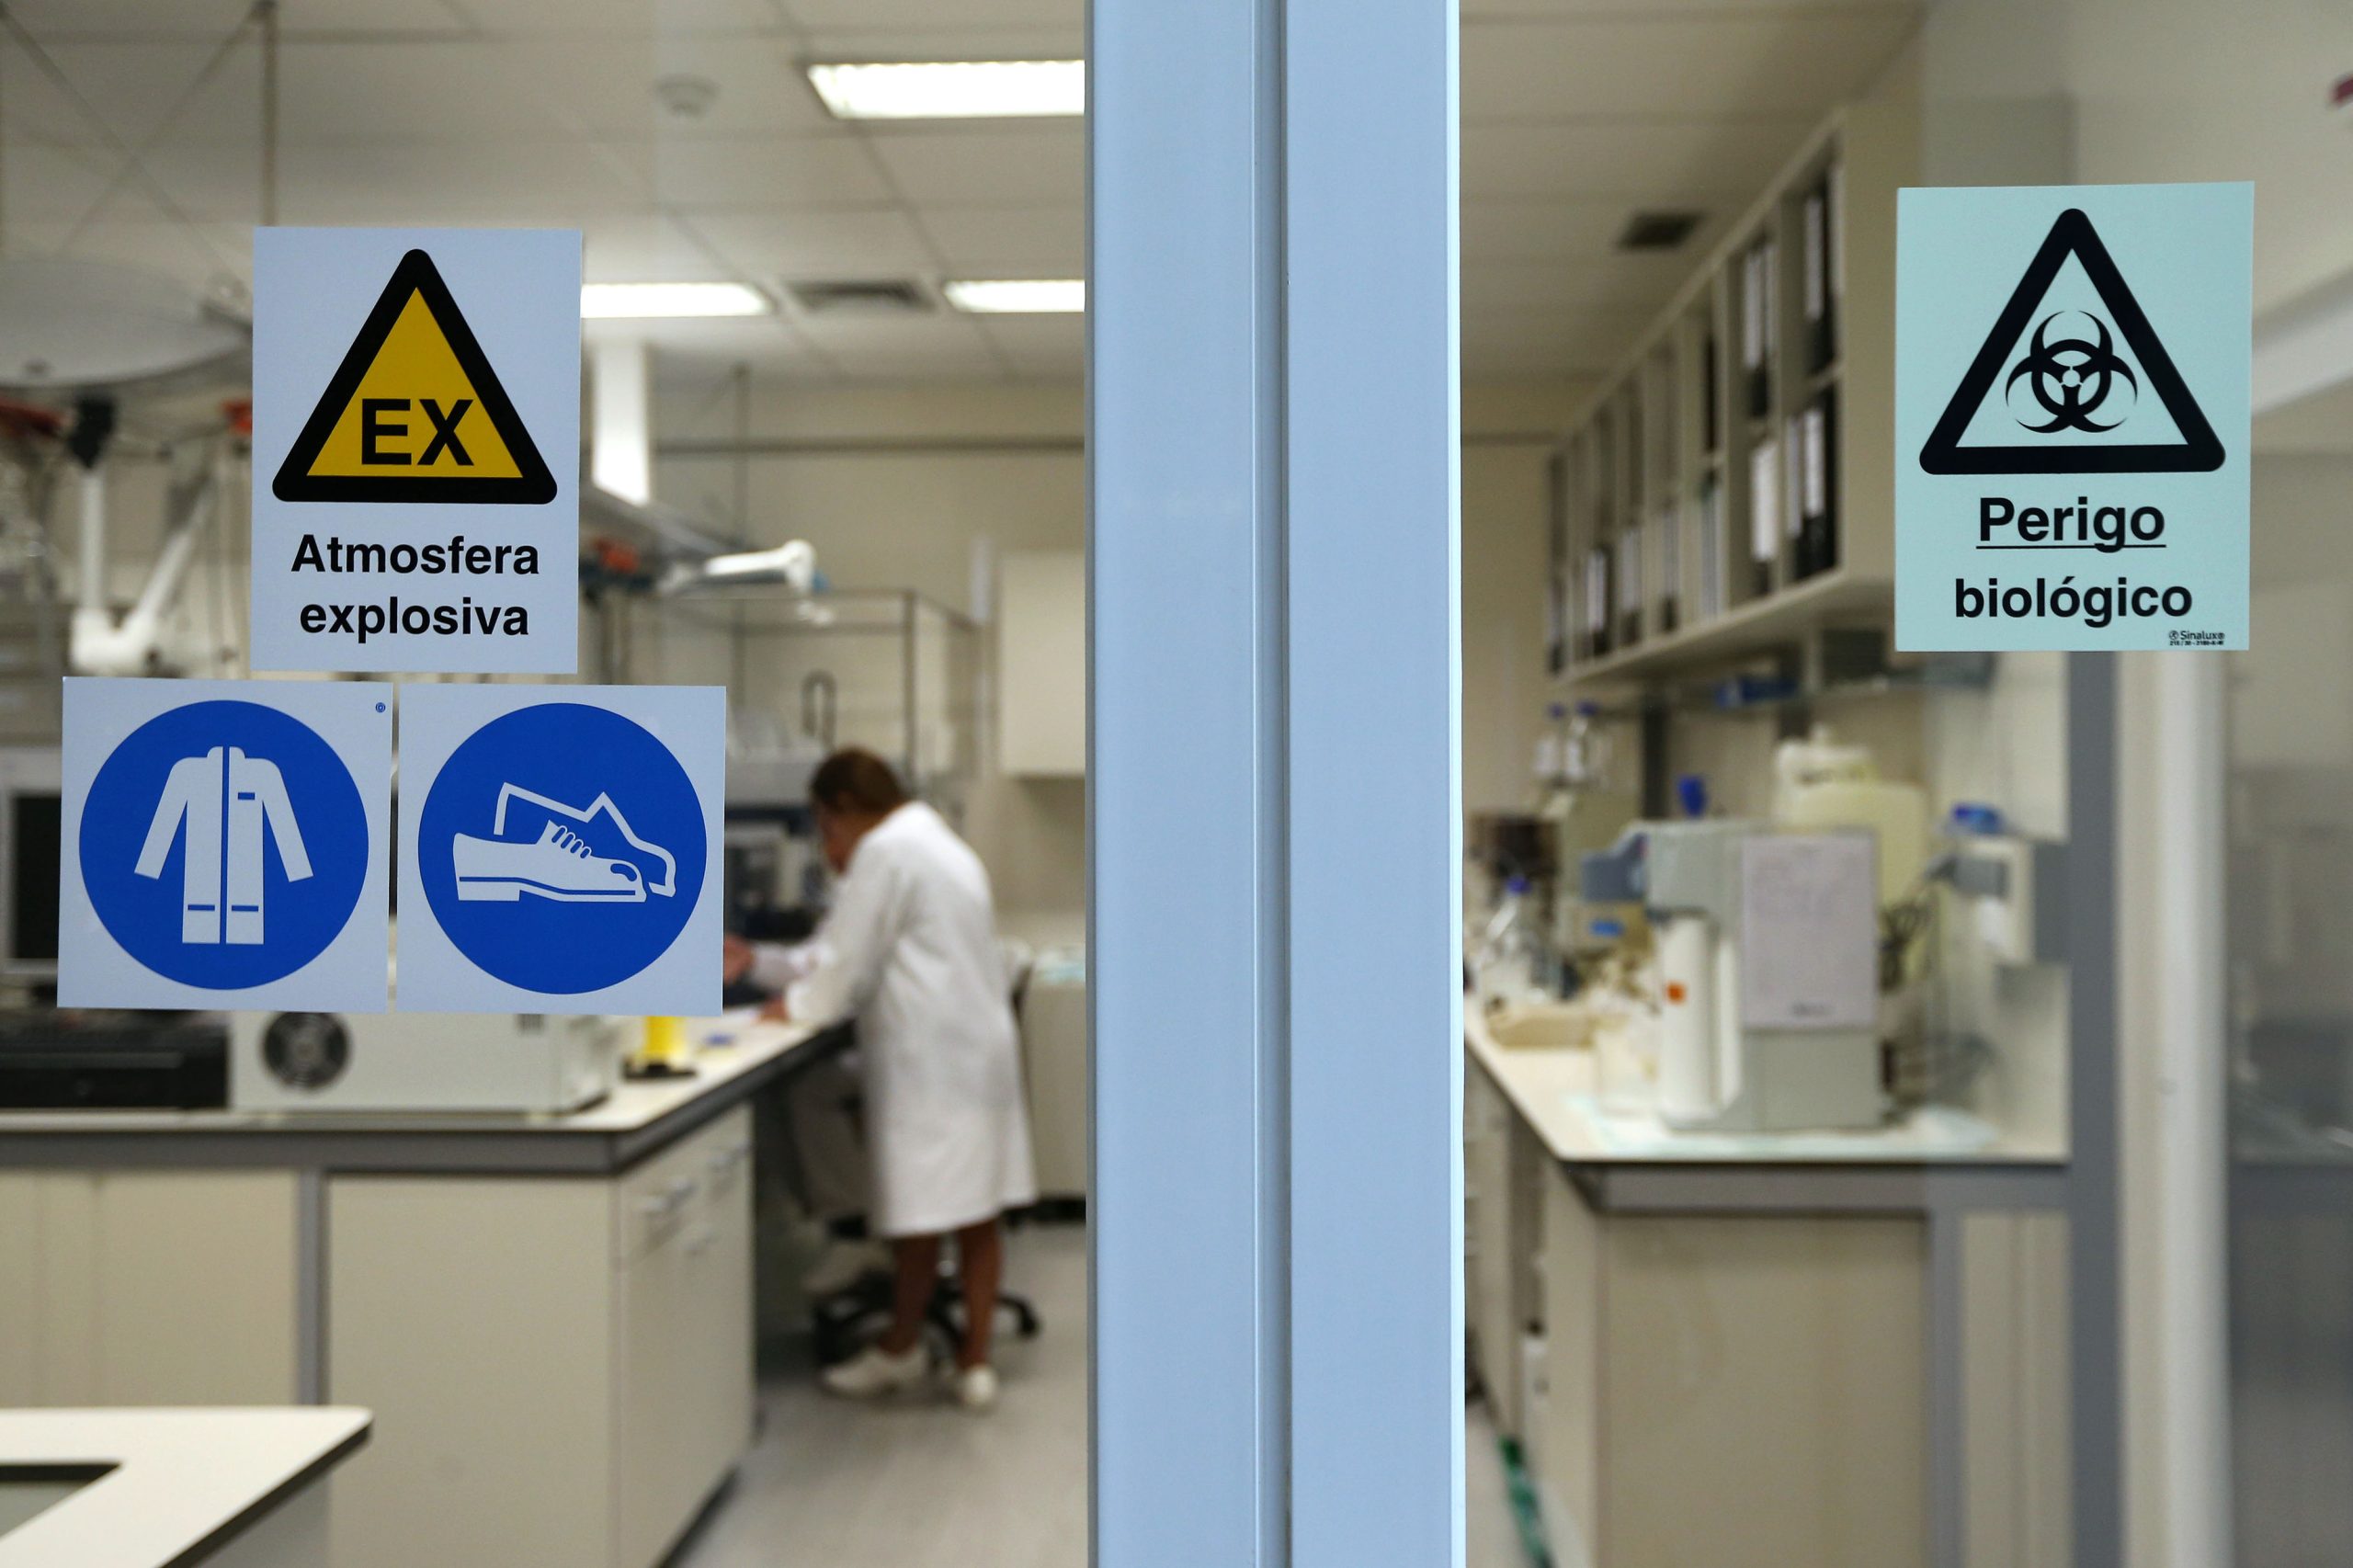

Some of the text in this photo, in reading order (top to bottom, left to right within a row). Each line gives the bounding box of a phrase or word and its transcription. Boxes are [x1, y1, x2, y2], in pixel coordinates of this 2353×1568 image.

[361, 398, 474, 466] EX
[1979, 495, 2165, 553] Perigo
[290, 534, 540, 575] Atmosfera
[300, 596, 529, 644] explosiva
[1955, 575, 2192, 629] biológico
